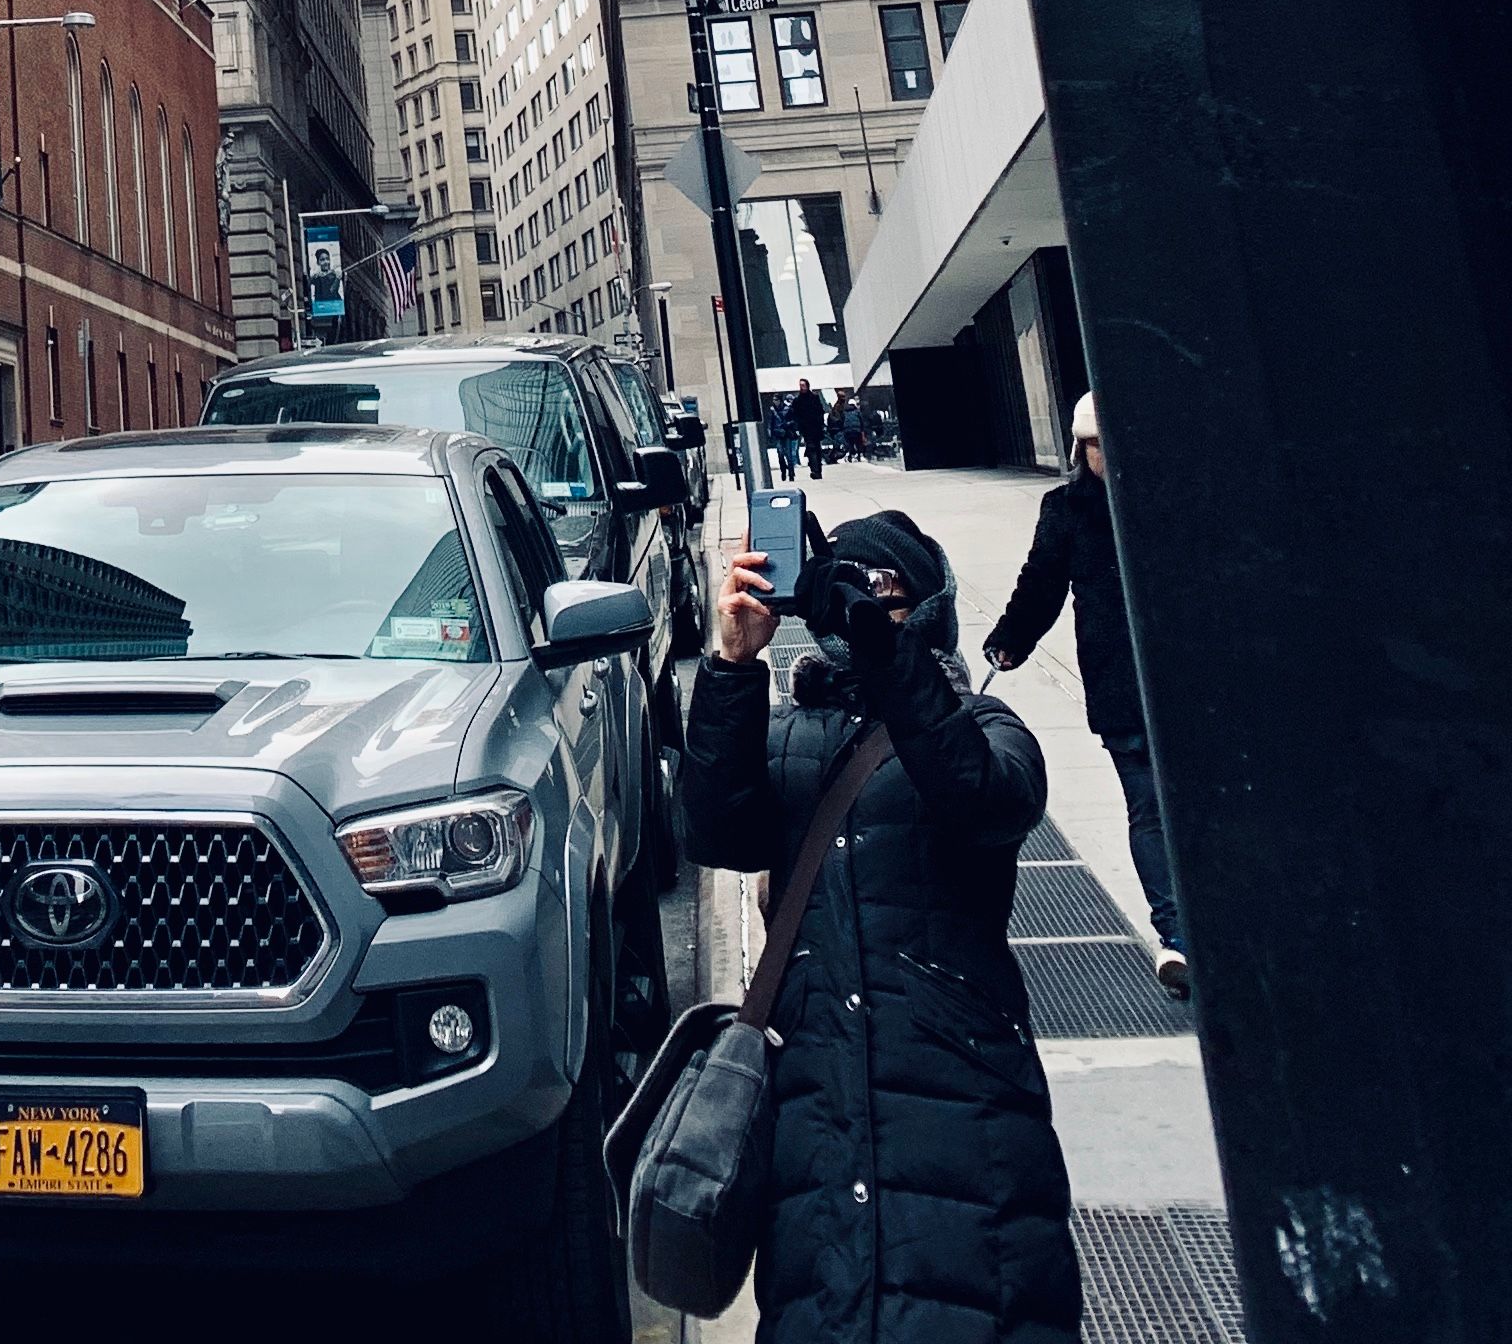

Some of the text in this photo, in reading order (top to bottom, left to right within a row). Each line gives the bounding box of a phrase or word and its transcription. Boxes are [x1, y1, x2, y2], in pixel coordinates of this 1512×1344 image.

[18, 1106, 100, 1122] NEW YORK
[64, 1126, 127, 1177] 4286
[19, 1178, 102, 1190] EMPIRE STATE
